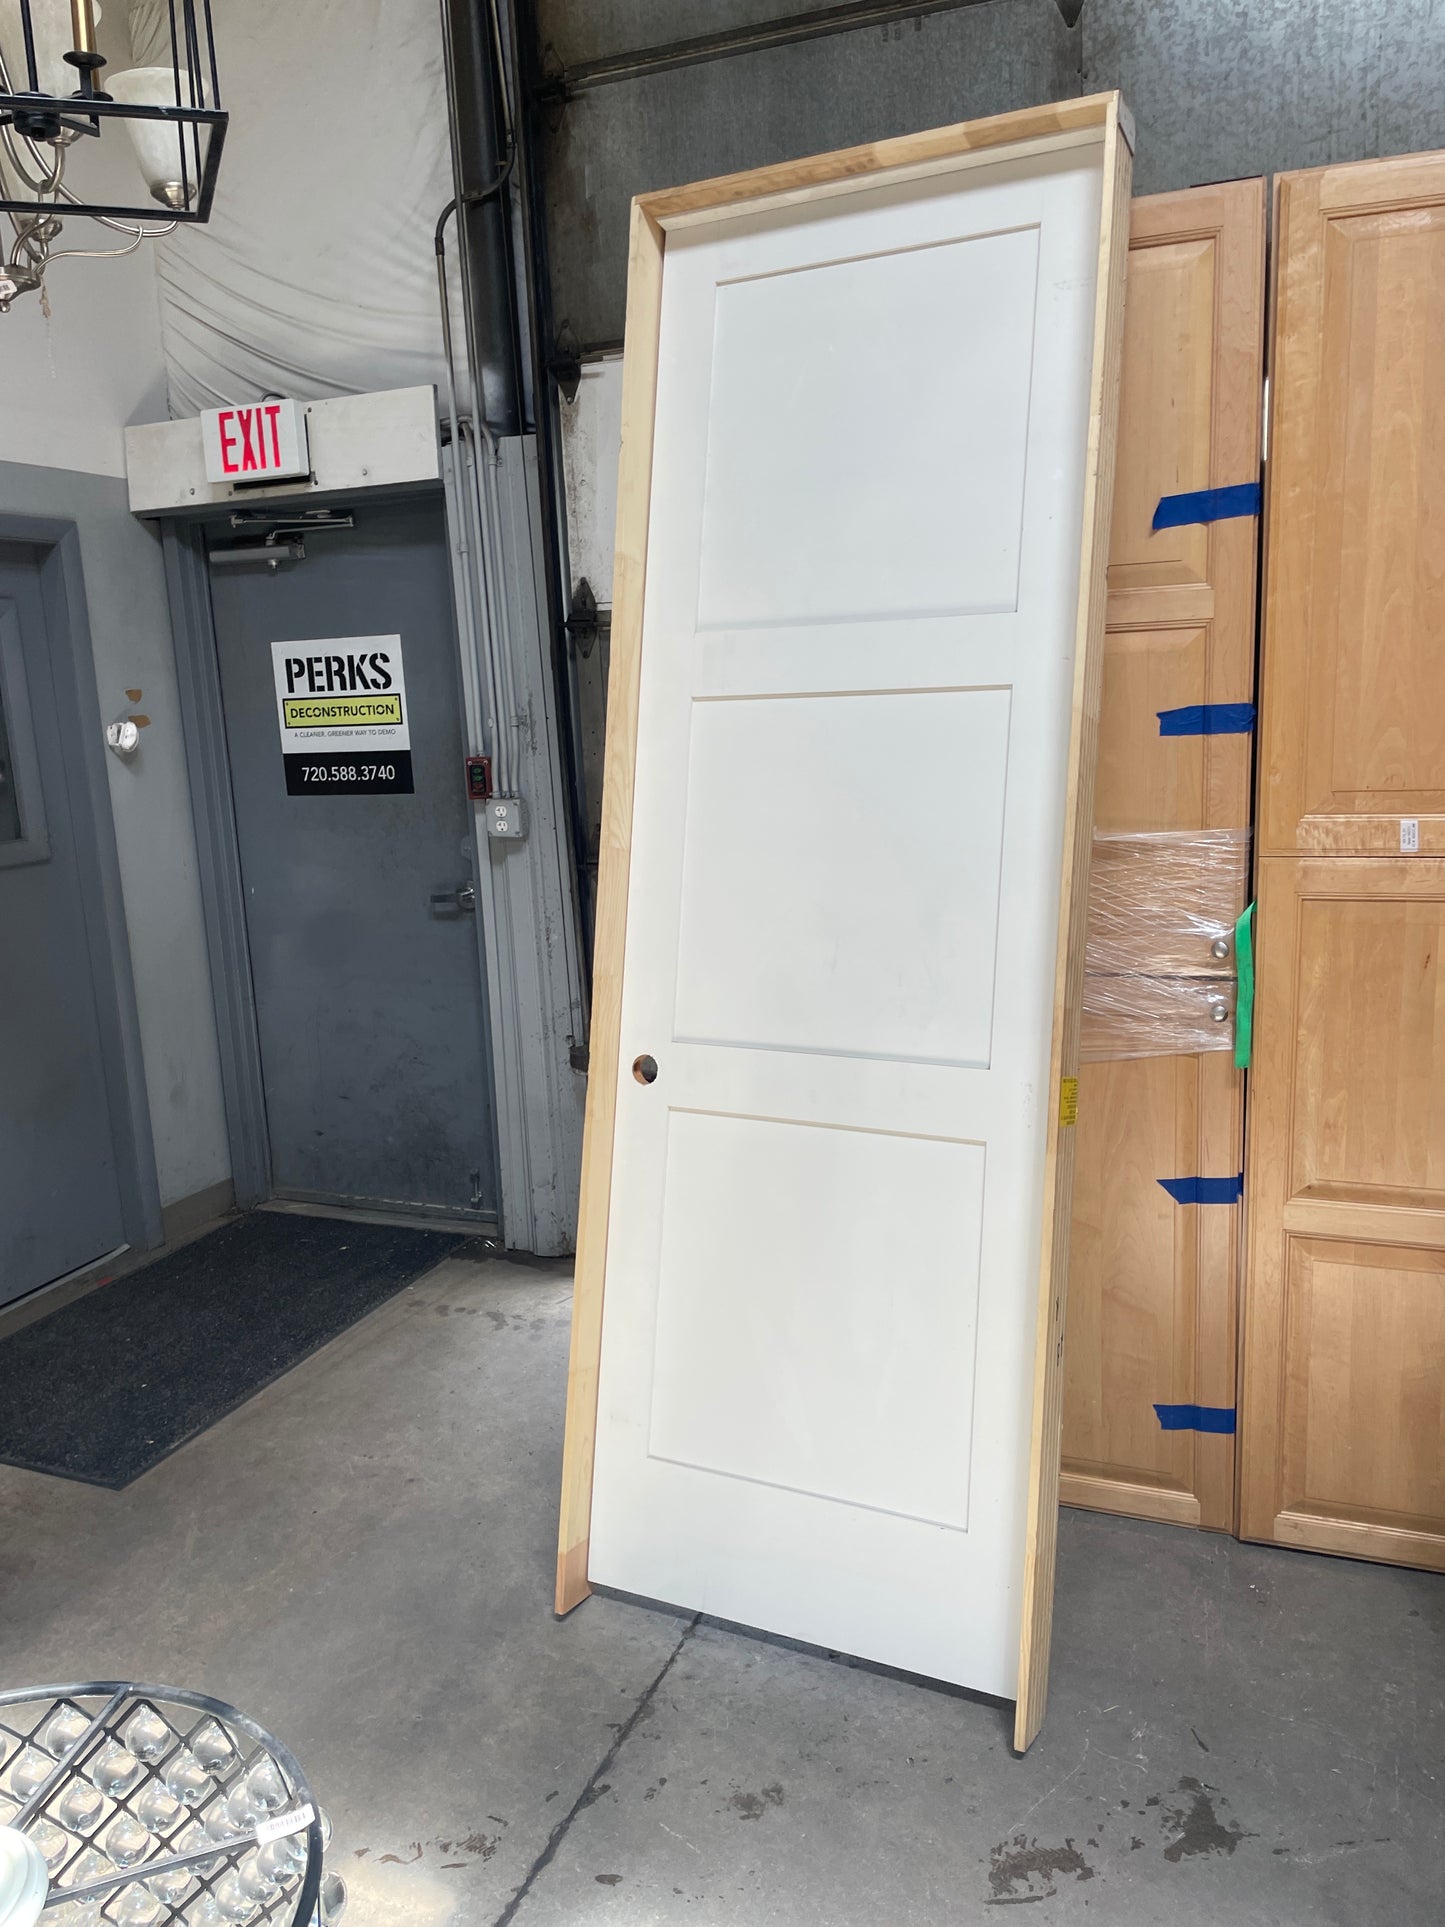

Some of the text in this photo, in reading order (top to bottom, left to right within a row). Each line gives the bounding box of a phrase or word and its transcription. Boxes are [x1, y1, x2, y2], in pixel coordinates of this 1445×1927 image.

[218, 404, 281, 474] EXIT
[285, 652, 392, 693] PERKS
[290, 704, 394, 719] DECONSTRUCTION
[327, 730, 354, 738] GREENER
[378, 728, 396, 736] DEMO
[301, 765, 396, 782] 720.588.3740
